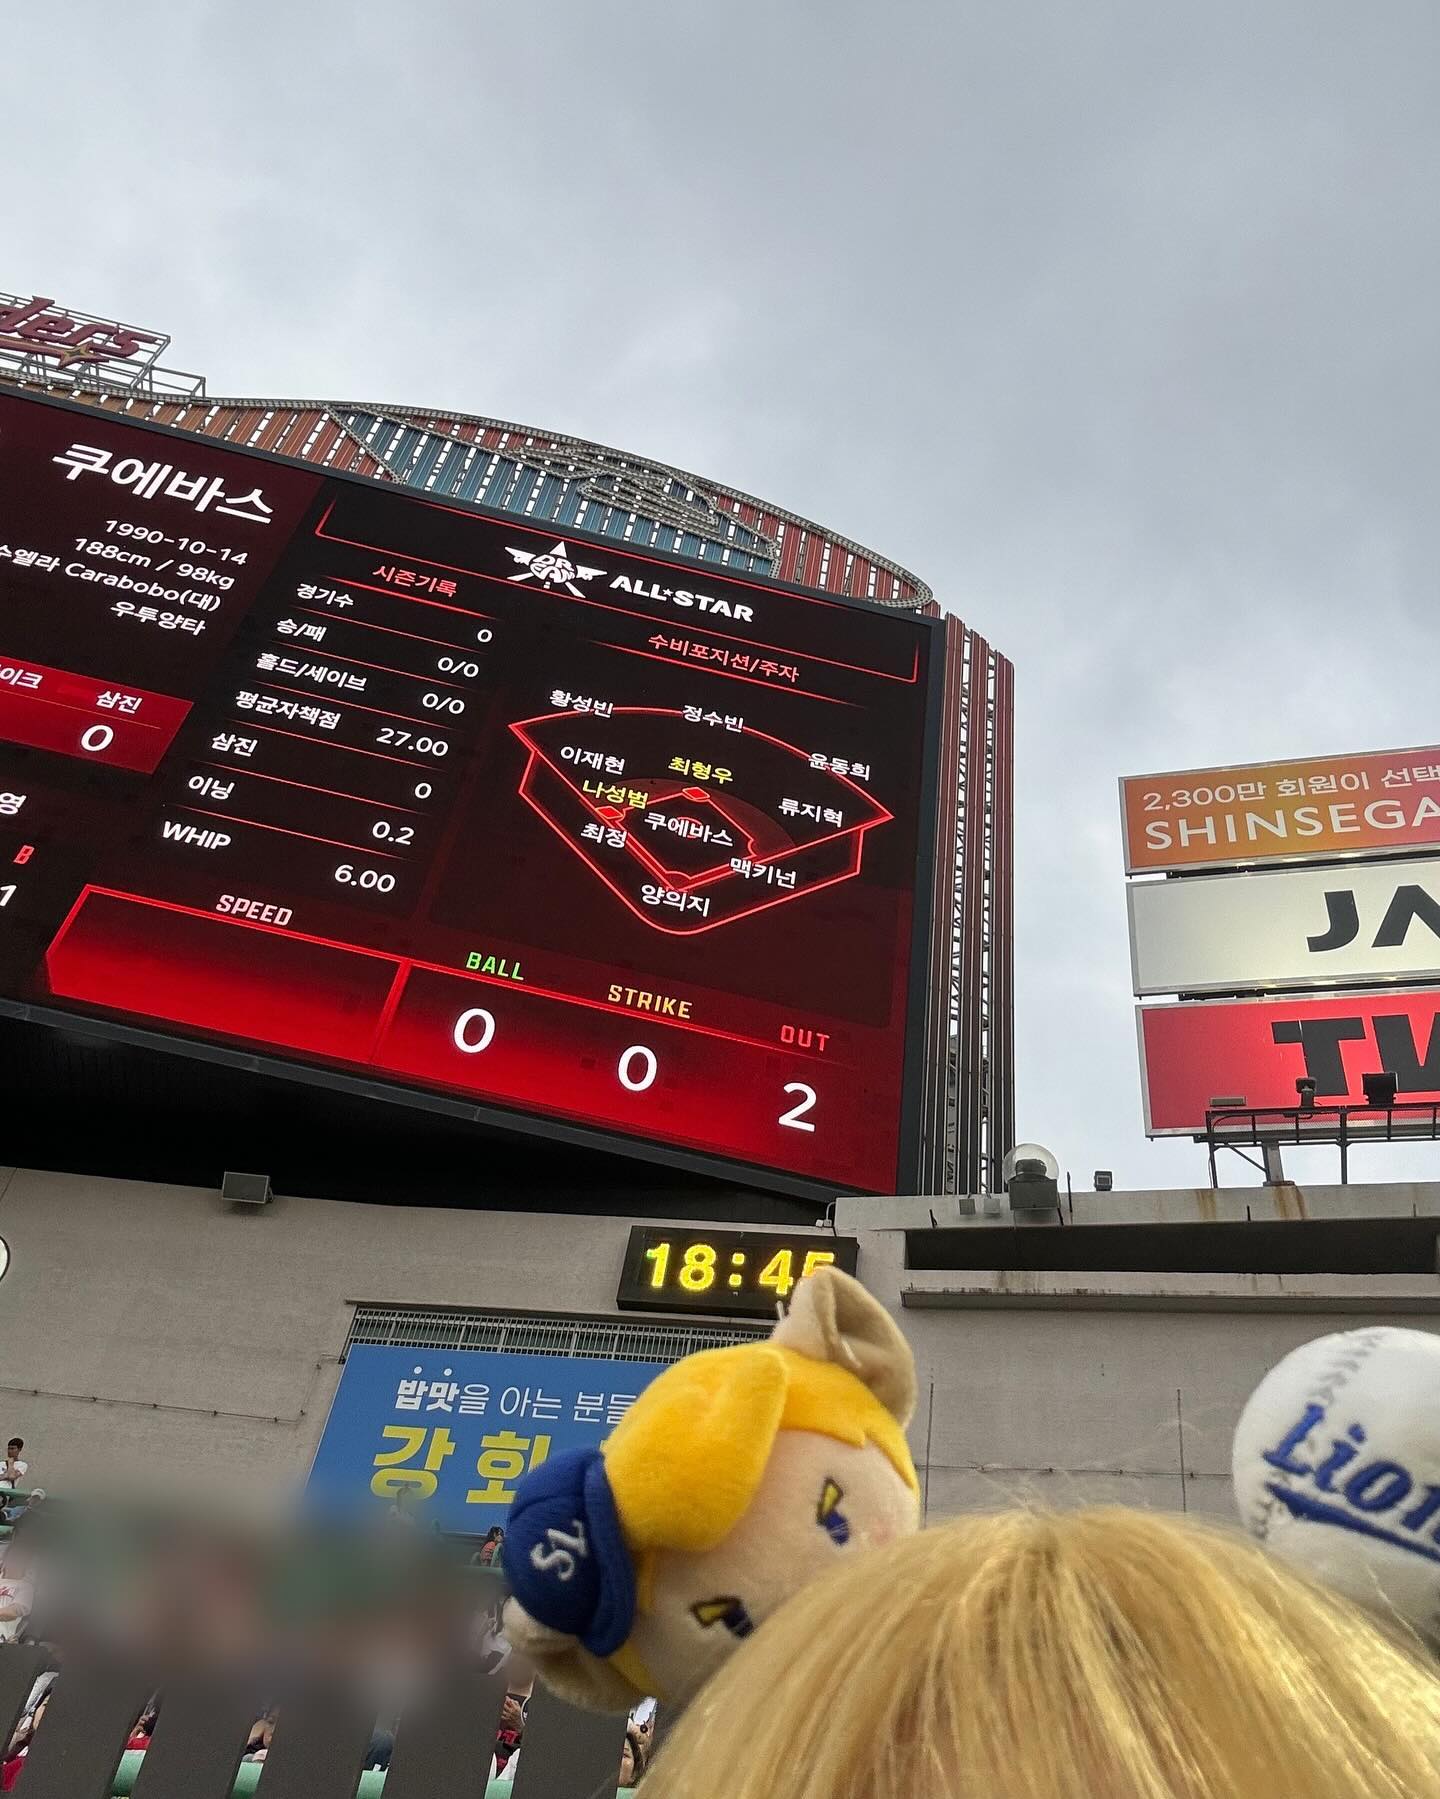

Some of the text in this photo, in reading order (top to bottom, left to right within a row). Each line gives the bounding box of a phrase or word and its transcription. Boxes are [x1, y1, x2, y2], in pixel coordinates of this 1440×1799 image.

[52, 443, 273, 524] 쿠에바스
[106, 520, 249, 565] 1990-10-14
[74, 538, 236, 590] 188cm / 98kg
[372, 565, 458, 598] 시즌기록
[65, 563, 221, 612] Carabobo(대)
[110, 601, 206, 636] 우투양타
[296, 583, 493, 643] 경기수 0
[276, 618, 479, 678] 승/패 0/0
[648, 634, 800, 683] 수비포지션/주자
[0, 664, 143, 714] 이크 삼진
[256, 652, 465, 715] 홀드/세이브 0/0
[549, 689, 614, 718] 황성빈
[682, 705, 744, 733] 정수빈
[81, 725, 114, 752] 0
[235, 690, 449, 757] 평균자책점 27.00
[211, 732, 433, 799] 삼진 0
[560, 746, 625, 775] 이재현
[668, 756, 733, 784] 최형우
[808, 752, 871, 781] 윤동희
[188, 775, 415, 845] 이닝 0.2
[582, 780, 649, 810] 나성범
[1143, 782, 1267, 812] 2,300만
[1276, 772, 1370, 798] 회원이
[644, 812, 734, 847] 쿠에바스
[778, 798, 843, 828] 류지혁
[1145, 796, 1440, 851] SHINSEGA
[580, 822, 628, 848] 최정
[13, 845, 35, 864] B
[161, 821, 396, 893] WHIP 6.00
[730, 857, 797, 889] 맥키넌
[215, 894, 293, 926] SPEED
[641, 884, 711, 918] 양의지
[466, 951, 525, 981] BALL
[608, 984, 693, 1019] STRIKE
[453, 1008, 496, 1053] 0
[780, 1024, 830, 1052] OUT
[618, 1045, 658, 1092] 0
[778, 1082, 817, 1132] 2
[395, 1379, 490, 1415] 밥맛을
[500, 1386, 562, 1420] 아는
